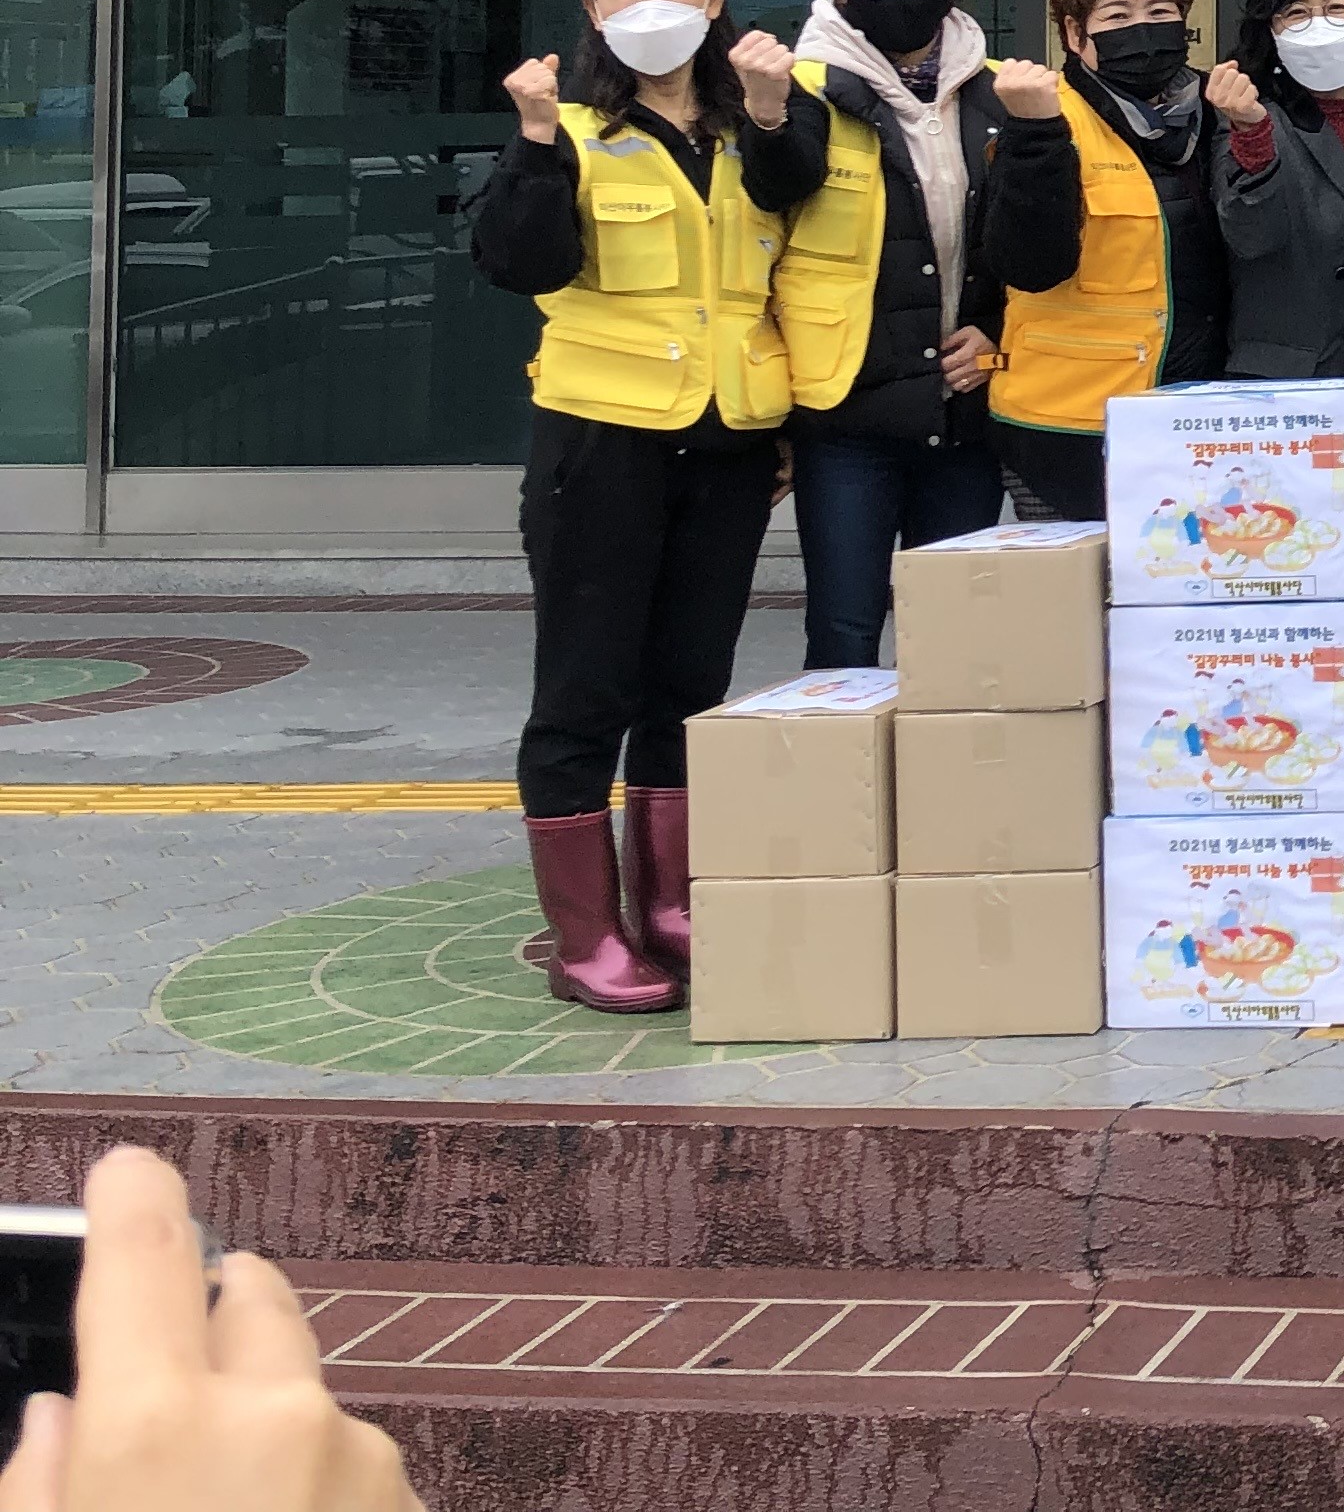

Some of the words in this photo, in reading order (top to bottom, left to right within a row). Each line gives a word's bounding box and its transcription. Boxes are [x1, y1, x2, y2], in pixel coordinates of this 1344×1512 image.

[1173, 416, 1224, 433] 2021년
[1228, 415, 1279, 432] 청소년과
[1282, 414, 1334, 430] 함께하는
[1259, 441, 1284, 456] 나눔
[1174, 628, 1225, 644] 2021년
[1229, 627, 1280, 644] 청소년과
[1283, 626, 1335, 642] 함께하는
[1260, 652, 1286, 668] 나눔
[1169, 838, 1221, 854] 2021년
[1225, 836, 1277, 854] 청소년과
[1280, 836, 1333, 853] 함께하는
[1257, 863, 1283, 879] 나눔
